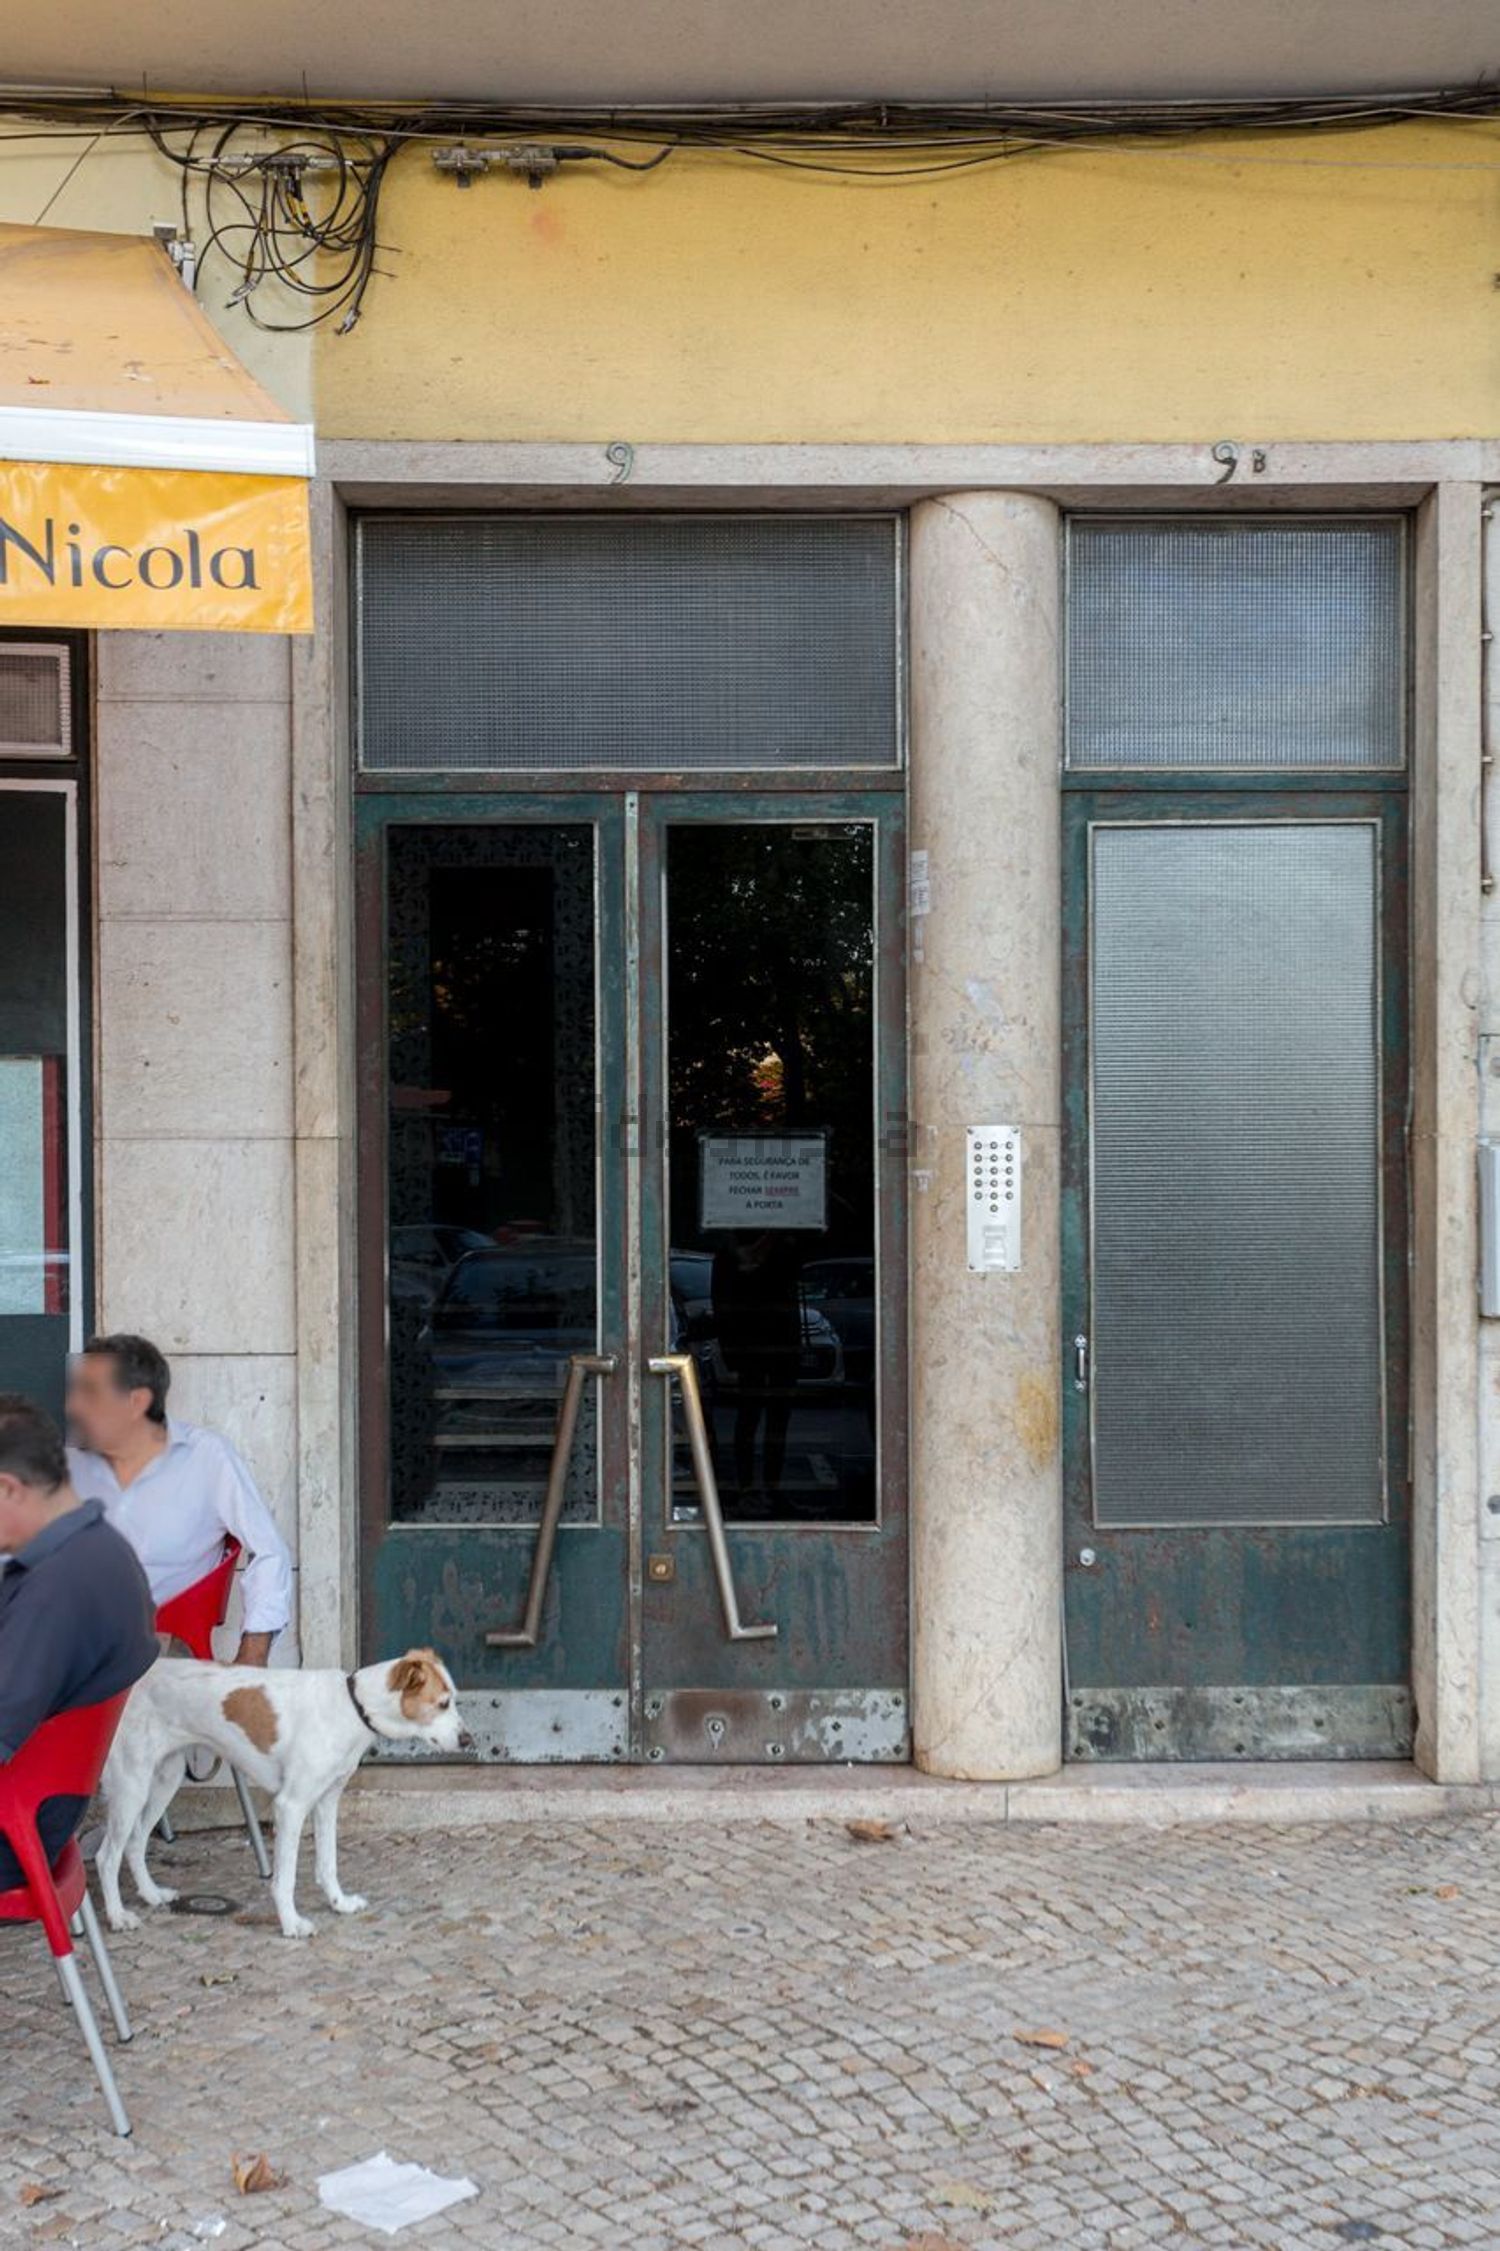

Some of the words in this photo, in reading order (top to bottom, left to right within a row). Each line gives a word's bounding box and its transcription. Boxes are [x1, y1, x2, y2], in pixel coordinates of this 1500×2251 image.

[606, 441, 634, 485] 9
[1211, 440, 1238, 485] 9
[1252, 448, 1266, 474] B
[0, 517, 261, 590] Nicola
[719, 1157, 741, 1166] PARA
[744, 1157, 796, 1168] SEGURANÇA
[798, 1157, 810, 1166] DE
[770, 1171, 800, 1180] FAVOR
[729, 1186, 763, 1195] FECHAR
[754, 1200, 784, 1209] PORTA
